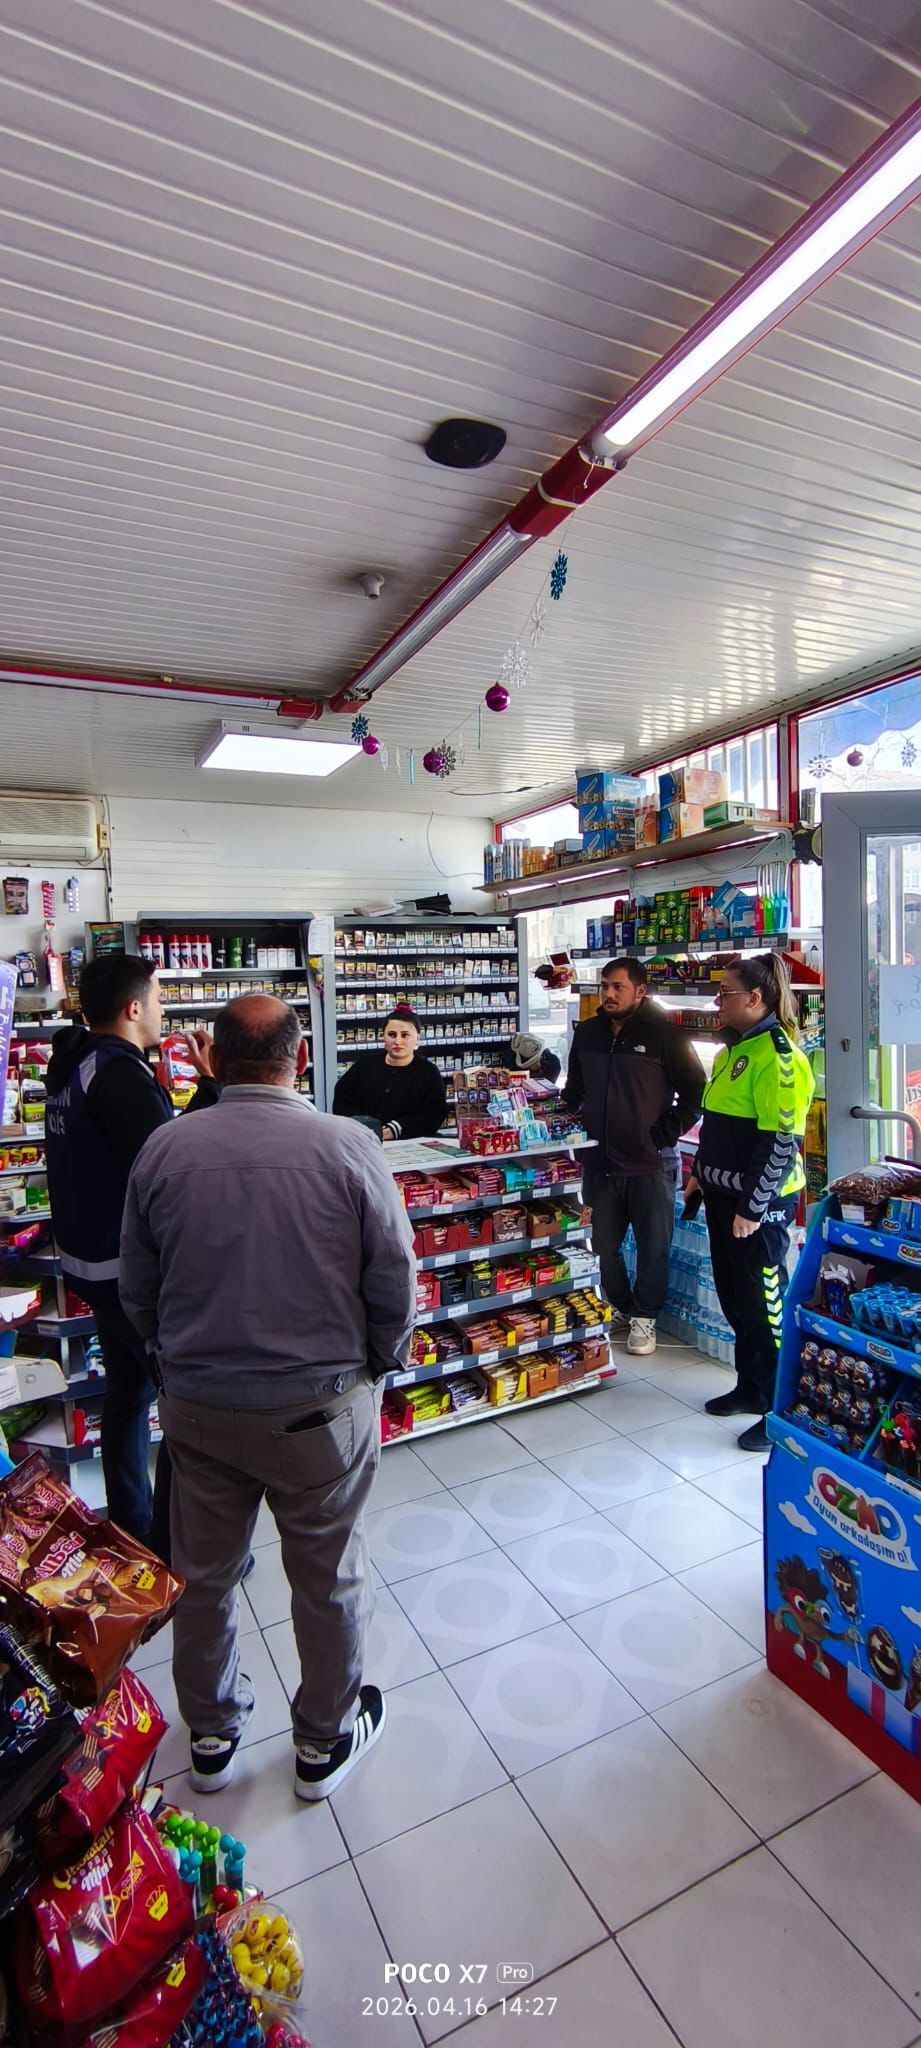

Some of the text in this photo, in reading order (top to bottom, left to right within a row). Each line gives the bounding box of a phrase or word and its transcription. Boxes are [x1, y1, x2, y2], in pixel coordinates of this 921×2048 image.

[34, 1530, 87, 1578] Albeni
[813, 1495, 838, 1525] Oyun
[840, 1521, 896, 1560] arkadaşım
